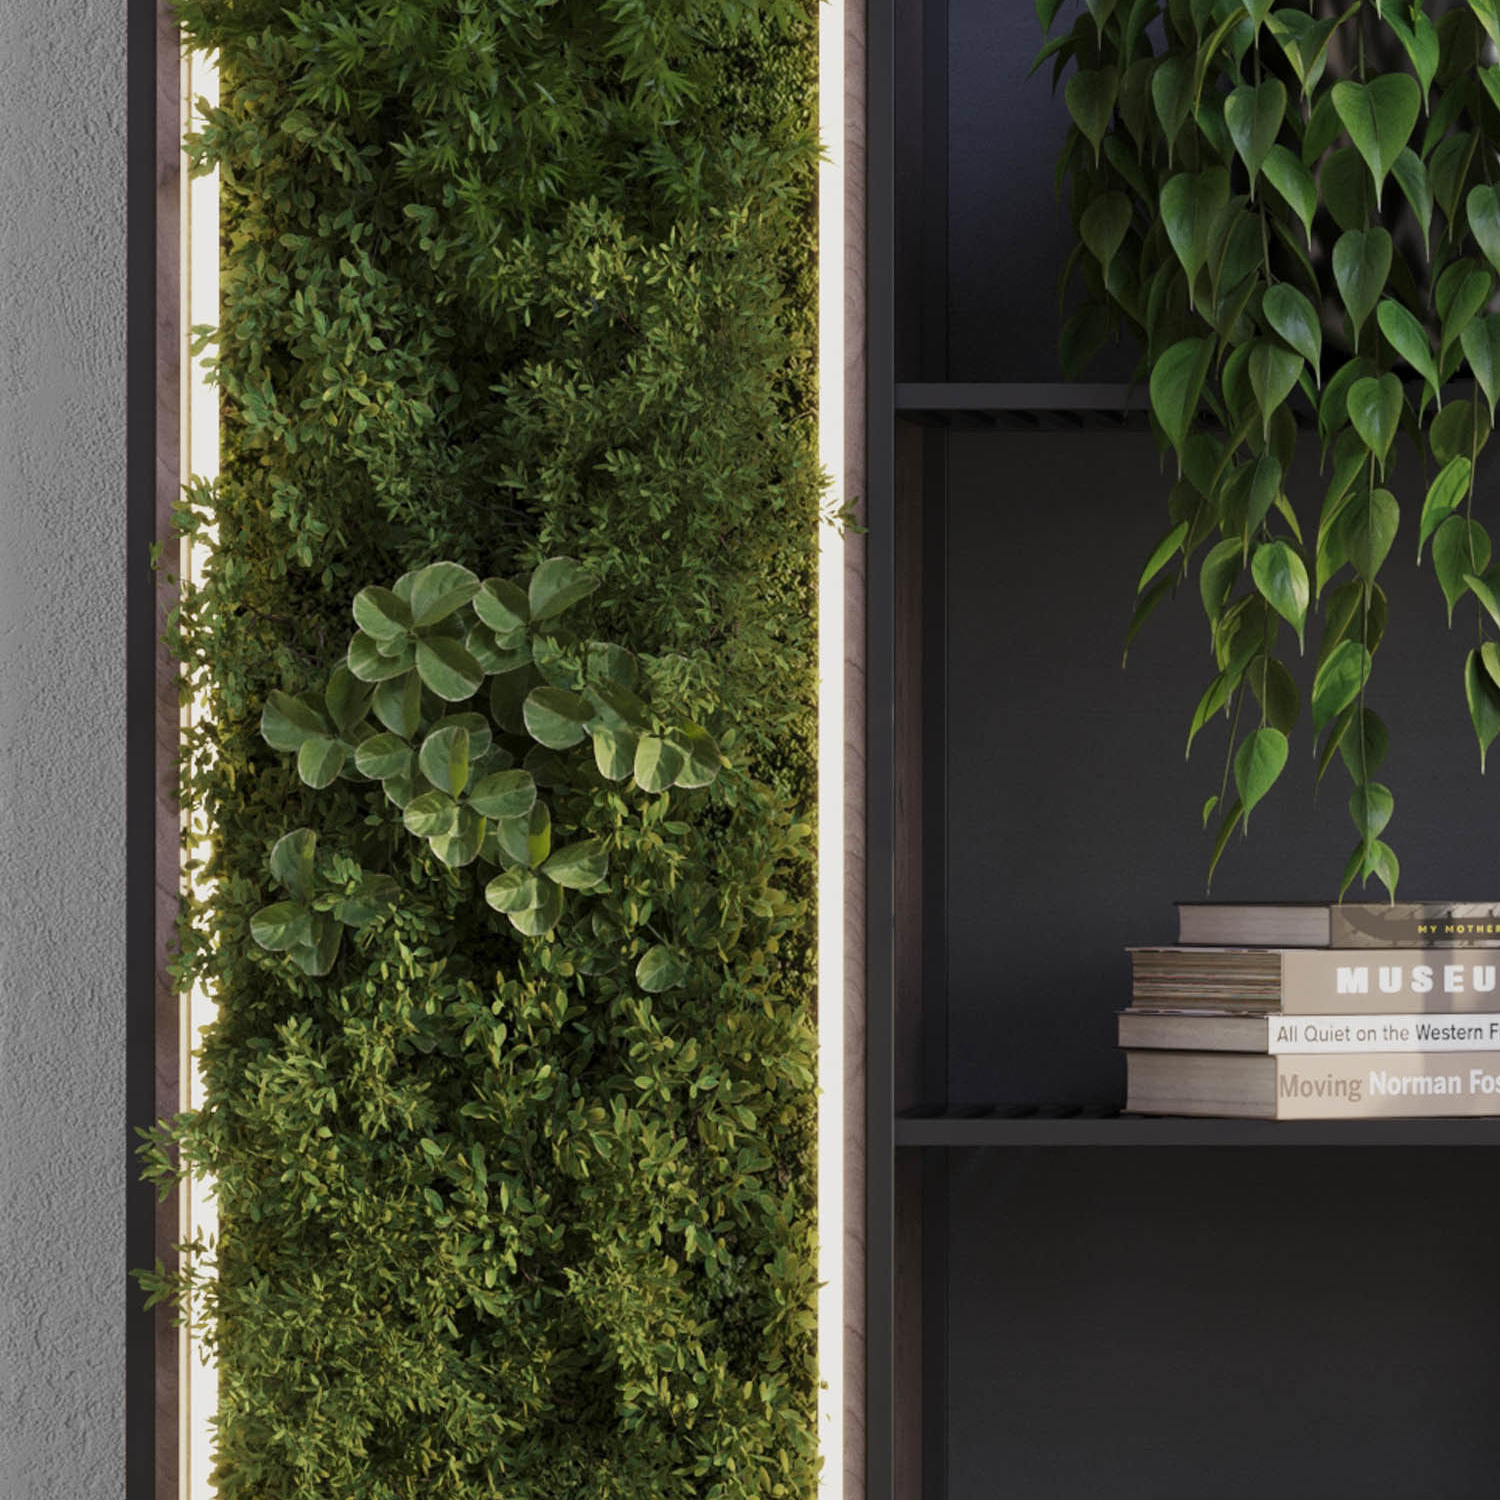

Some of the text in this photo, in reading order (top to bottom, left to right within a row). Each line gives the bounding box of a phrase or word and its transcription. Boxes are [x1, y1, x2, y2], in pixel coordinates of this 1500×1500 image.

[1417, 924, 1438, 934] MY
[1277, 1025, 1298, 1042] All
[1304, 1025, 1350, 1042] Quiet
[1356, 1028, 1377, 1041] on
[1383, 1025, 1409, 1041] the
[1416, 1023, 1483, 1040] Western
[1279, 1074, 1362, 1102] Moving
[1369, 1070, 1461, 1095] Norman
